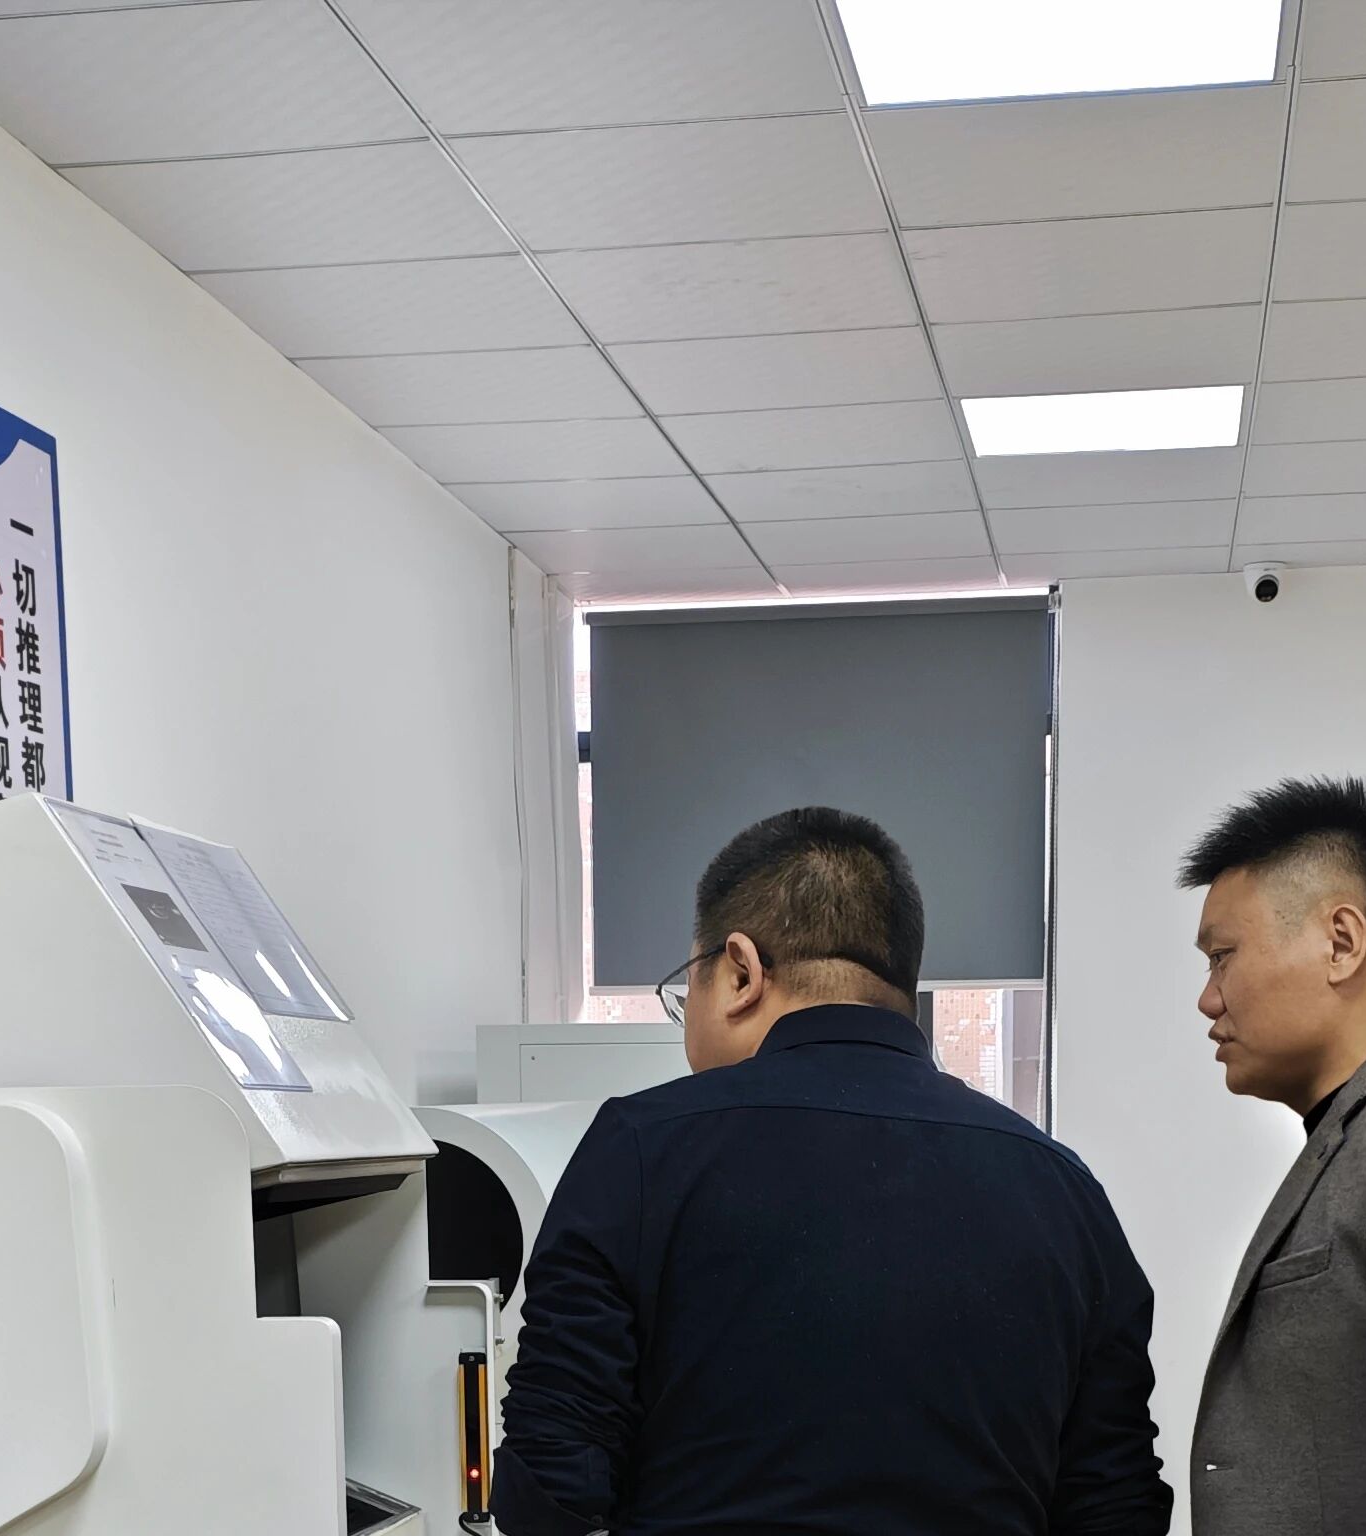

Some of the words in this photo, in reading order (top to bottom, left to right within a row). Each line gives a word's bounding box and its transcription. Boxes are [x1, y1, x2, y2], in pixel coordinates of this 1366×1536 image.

[10, 518, 46, 793] 一切推理都
